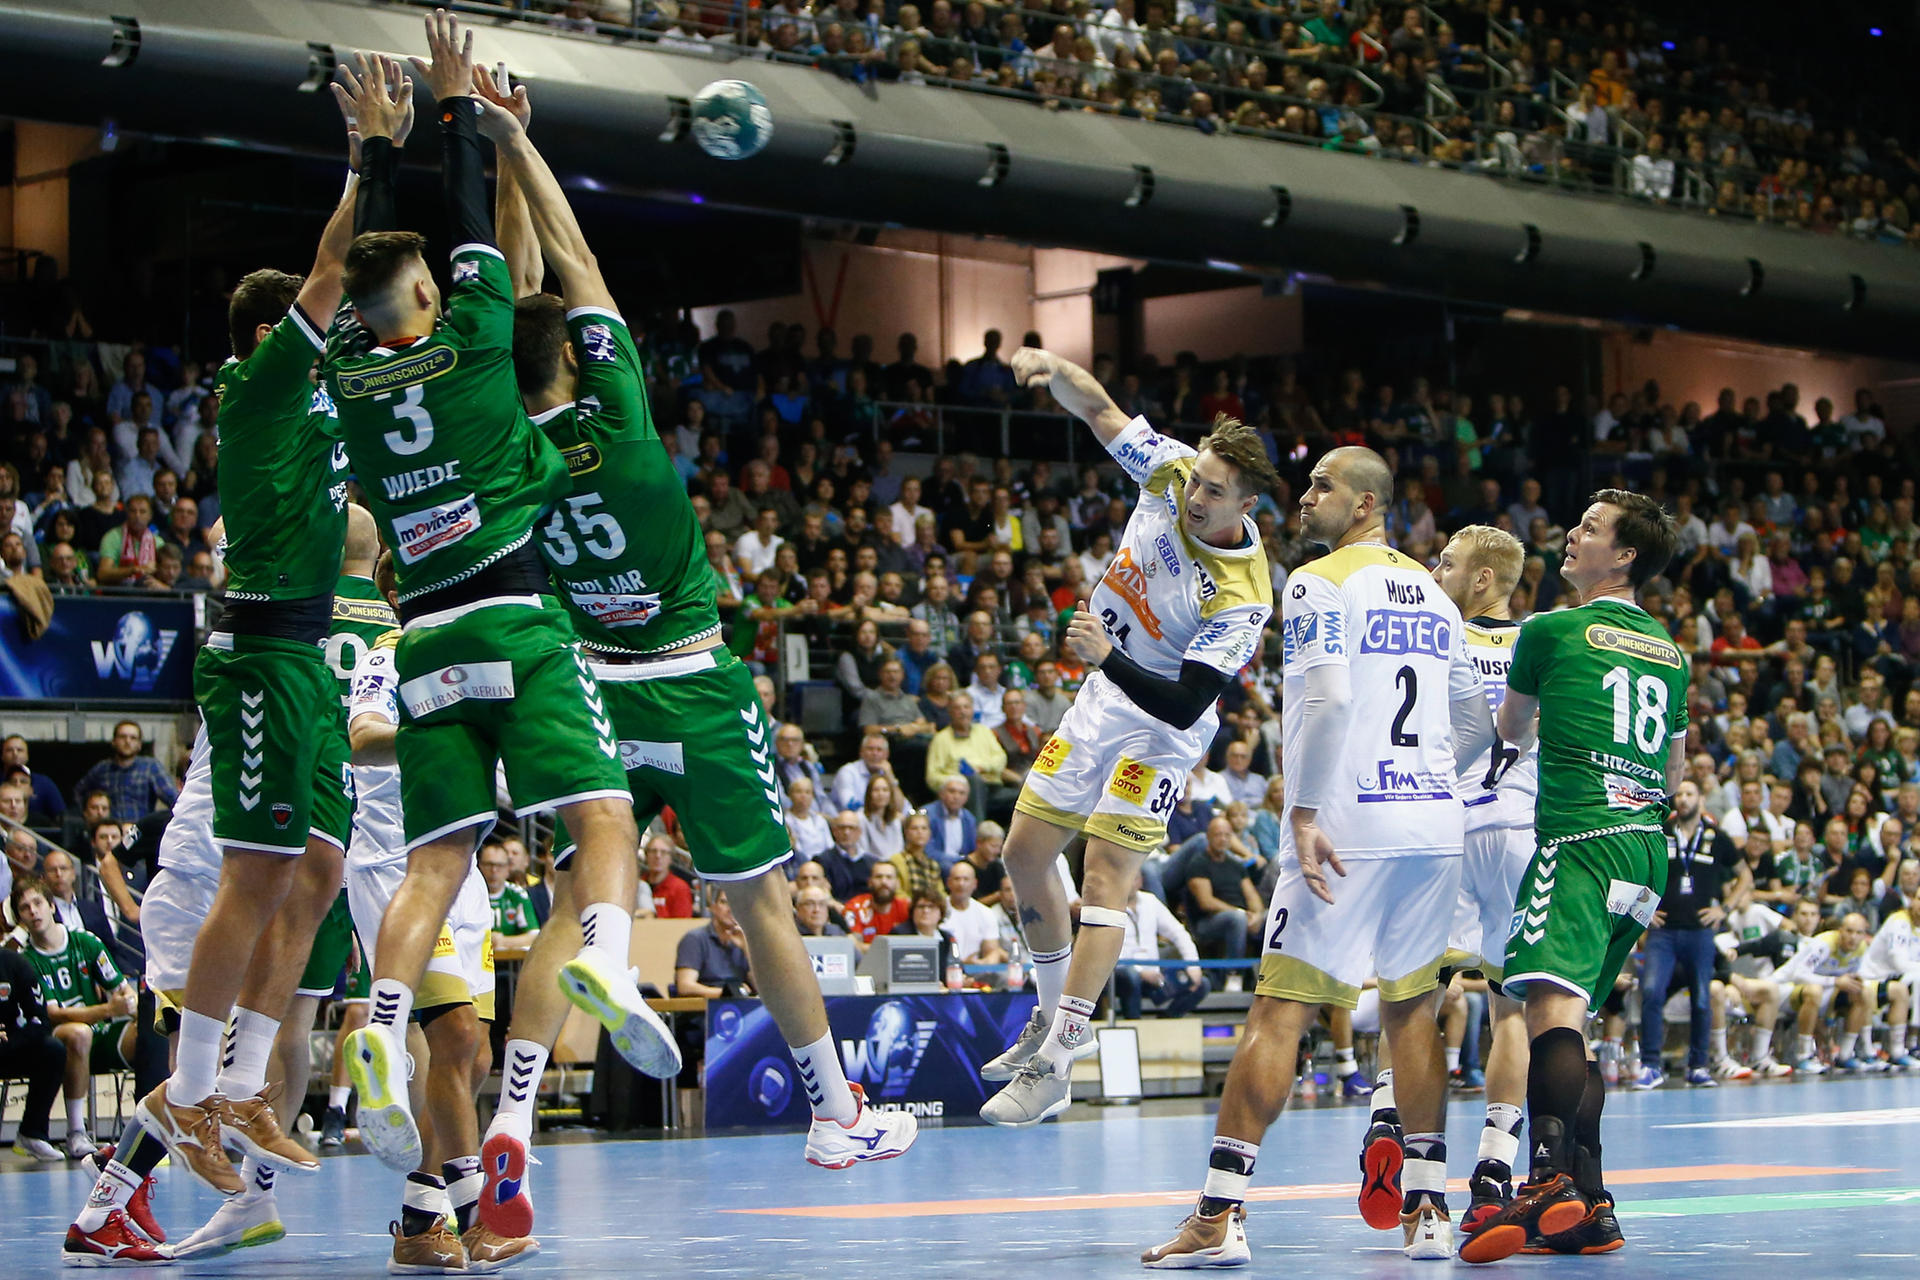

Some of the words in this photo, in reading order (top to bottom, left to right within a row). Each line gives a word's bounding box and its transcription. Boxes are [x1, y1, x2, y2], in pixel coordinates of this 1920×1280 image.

[374, 383, 434, 456] 3
[382, 460, 461, 500] WIEDE
[400, 503, 472, 543] movinga
[543, 492, 626, 566] 35
[1156, 534, 1180, 577] GETEC
[1385, 578, 1425, 605] MUSA
[1323, 611, 1343, 655] SWM
[1365, 613, 1450, 657] GETEC
[472, 684, 512, 698] BERLIN
[1390, 665, 1418, 748] 2
[1602, 666, 1669, 755] 18
[1113, 777, 1141, 794] LOTTO
[1117, 824, 1145, 841] Kempa
[1269, 908, 1288, 949] 2
